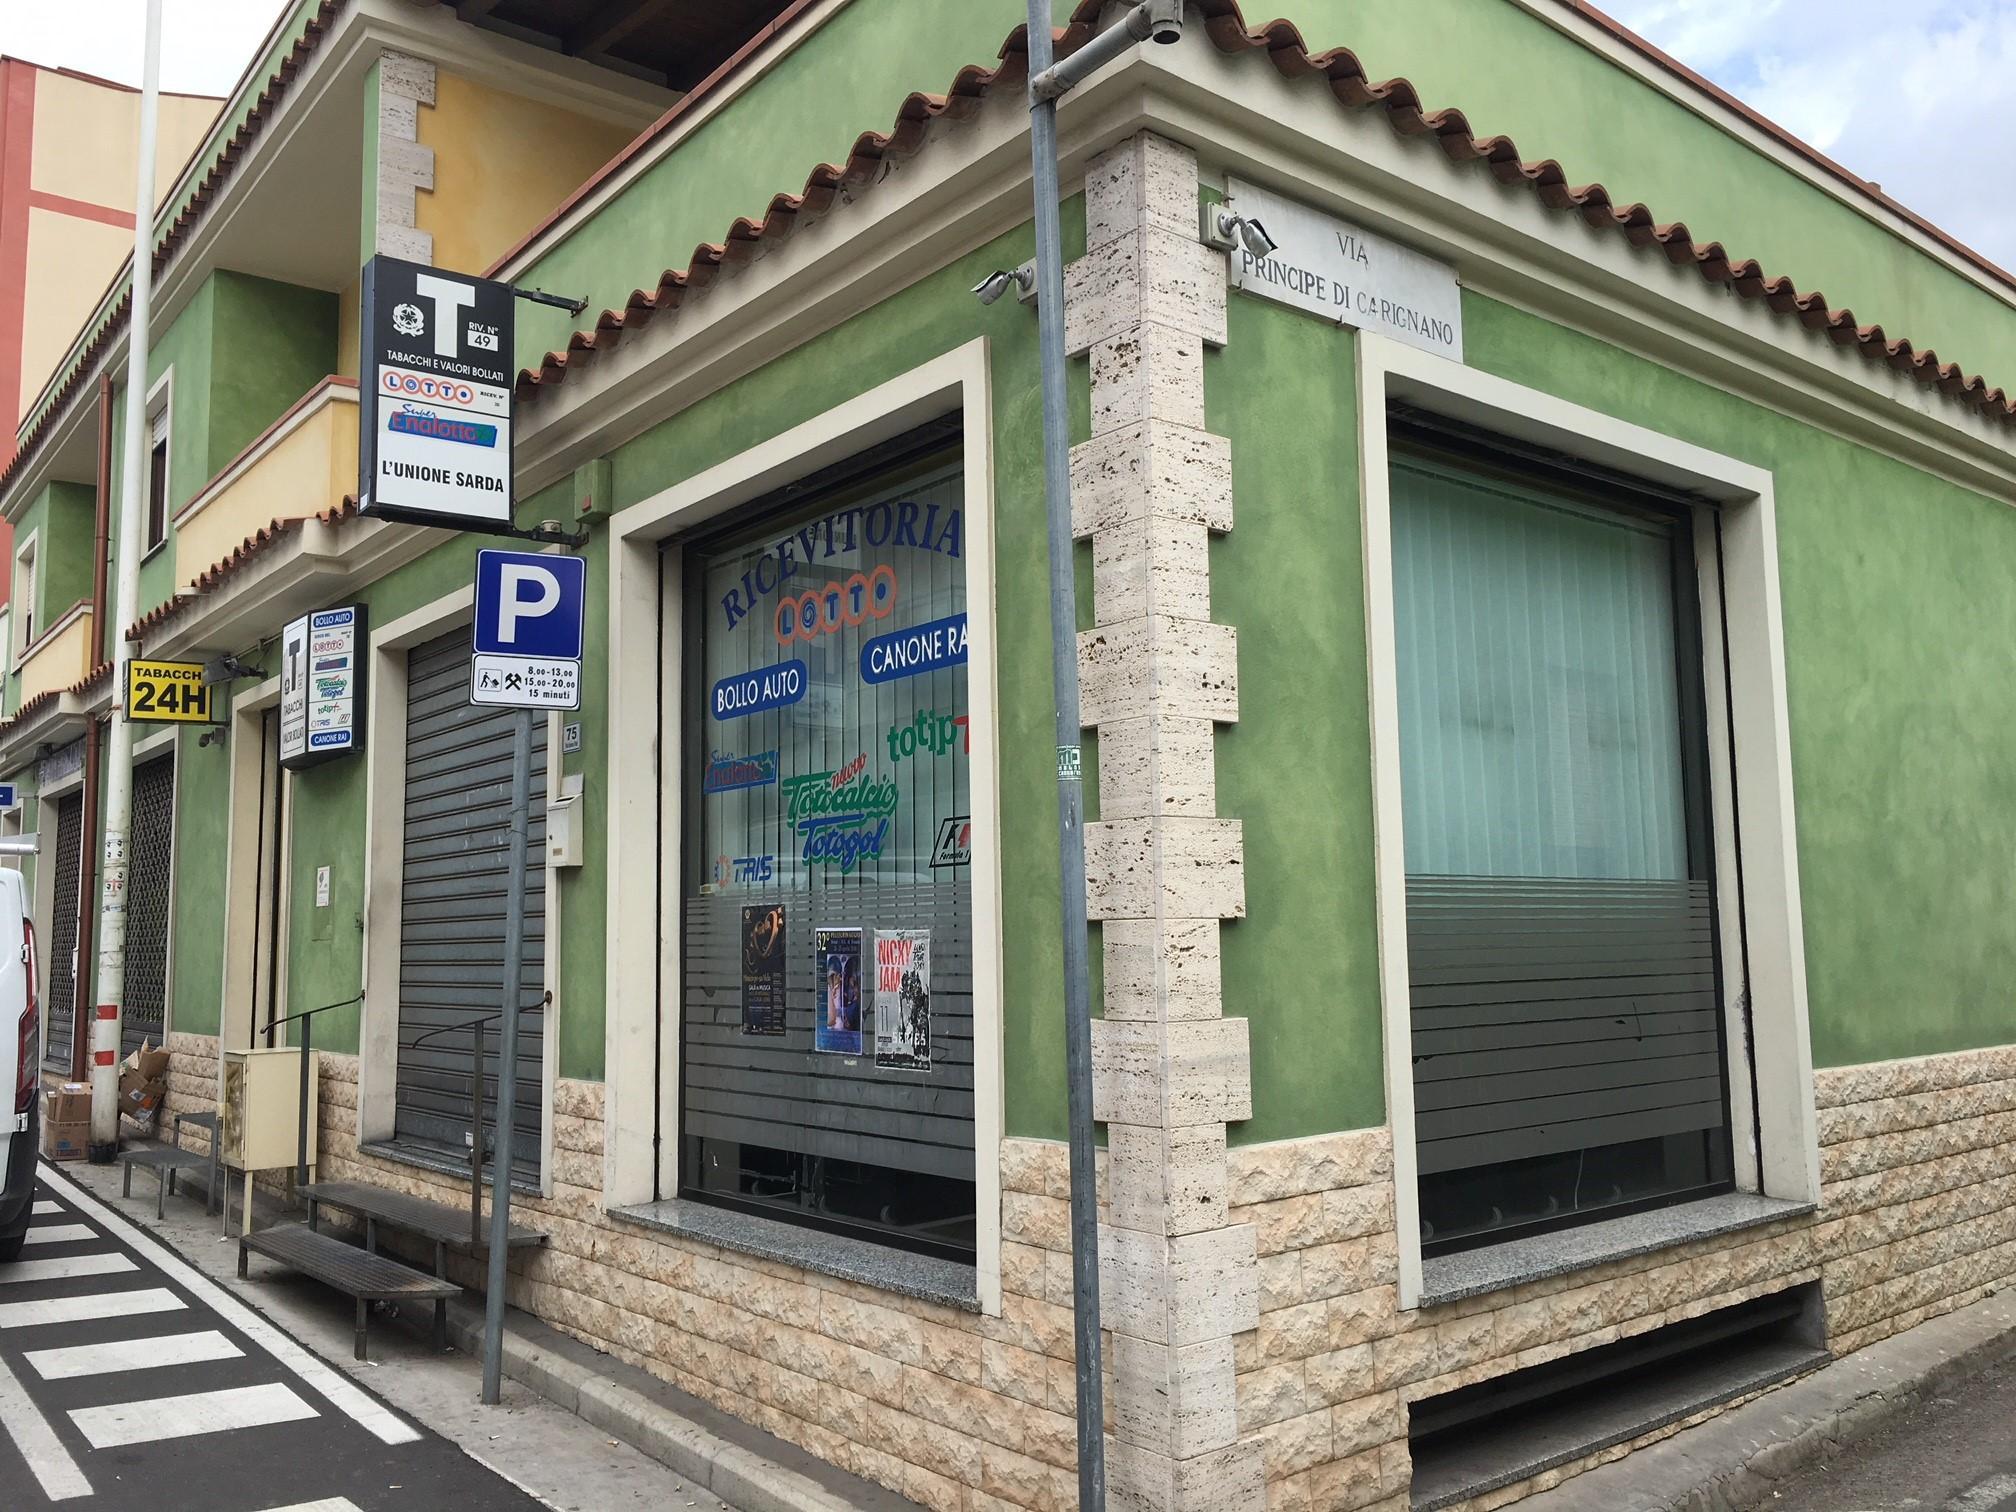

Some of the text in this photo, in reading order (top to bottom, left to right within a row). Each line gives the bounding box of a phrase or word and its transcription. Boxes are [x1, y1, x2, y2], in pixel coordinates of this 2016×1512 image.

[1336, 231, 1369, 265] VIA
[1241, 249, 1453, 345] PRINCIPE DI CARIGNANO
[416, 272, 476, 359] T
[468, 321, 486, 333] RIV.
[473, 334, 491, 348] 49
[387, 350, 504, 382] TABACCHI E VALORI BOLLATI
[383, 371, 474, 404] LOTTO
[382, 460, 504, 493] L'UNIONE SARDA
[720, 501, 961, 632] RICEVITORIA
[315, 612, 351, 627] BOLLO AUTO
[497, 563, 561, 643] P
[774, 564, 897, 647] LOTTO
[871, 622, 968, 674] CANONE RA
[134, 667, 202, 680] TABACCH
[133, 681, 206, 715] 24H
[529, 689, 571, 700] 15 minuti
[717, 669, 800, 713] BOLLO AUTO
[314, 733, 347, 744] CANONE RAI
[566, 726, 577, 741] 75
[831, 752, 867, 790] nuovo
[783, 770, 898, 829] Totocalcio
[797, 813, 890, 875] Totogol
[732, 855, 774, 883] TRIS
